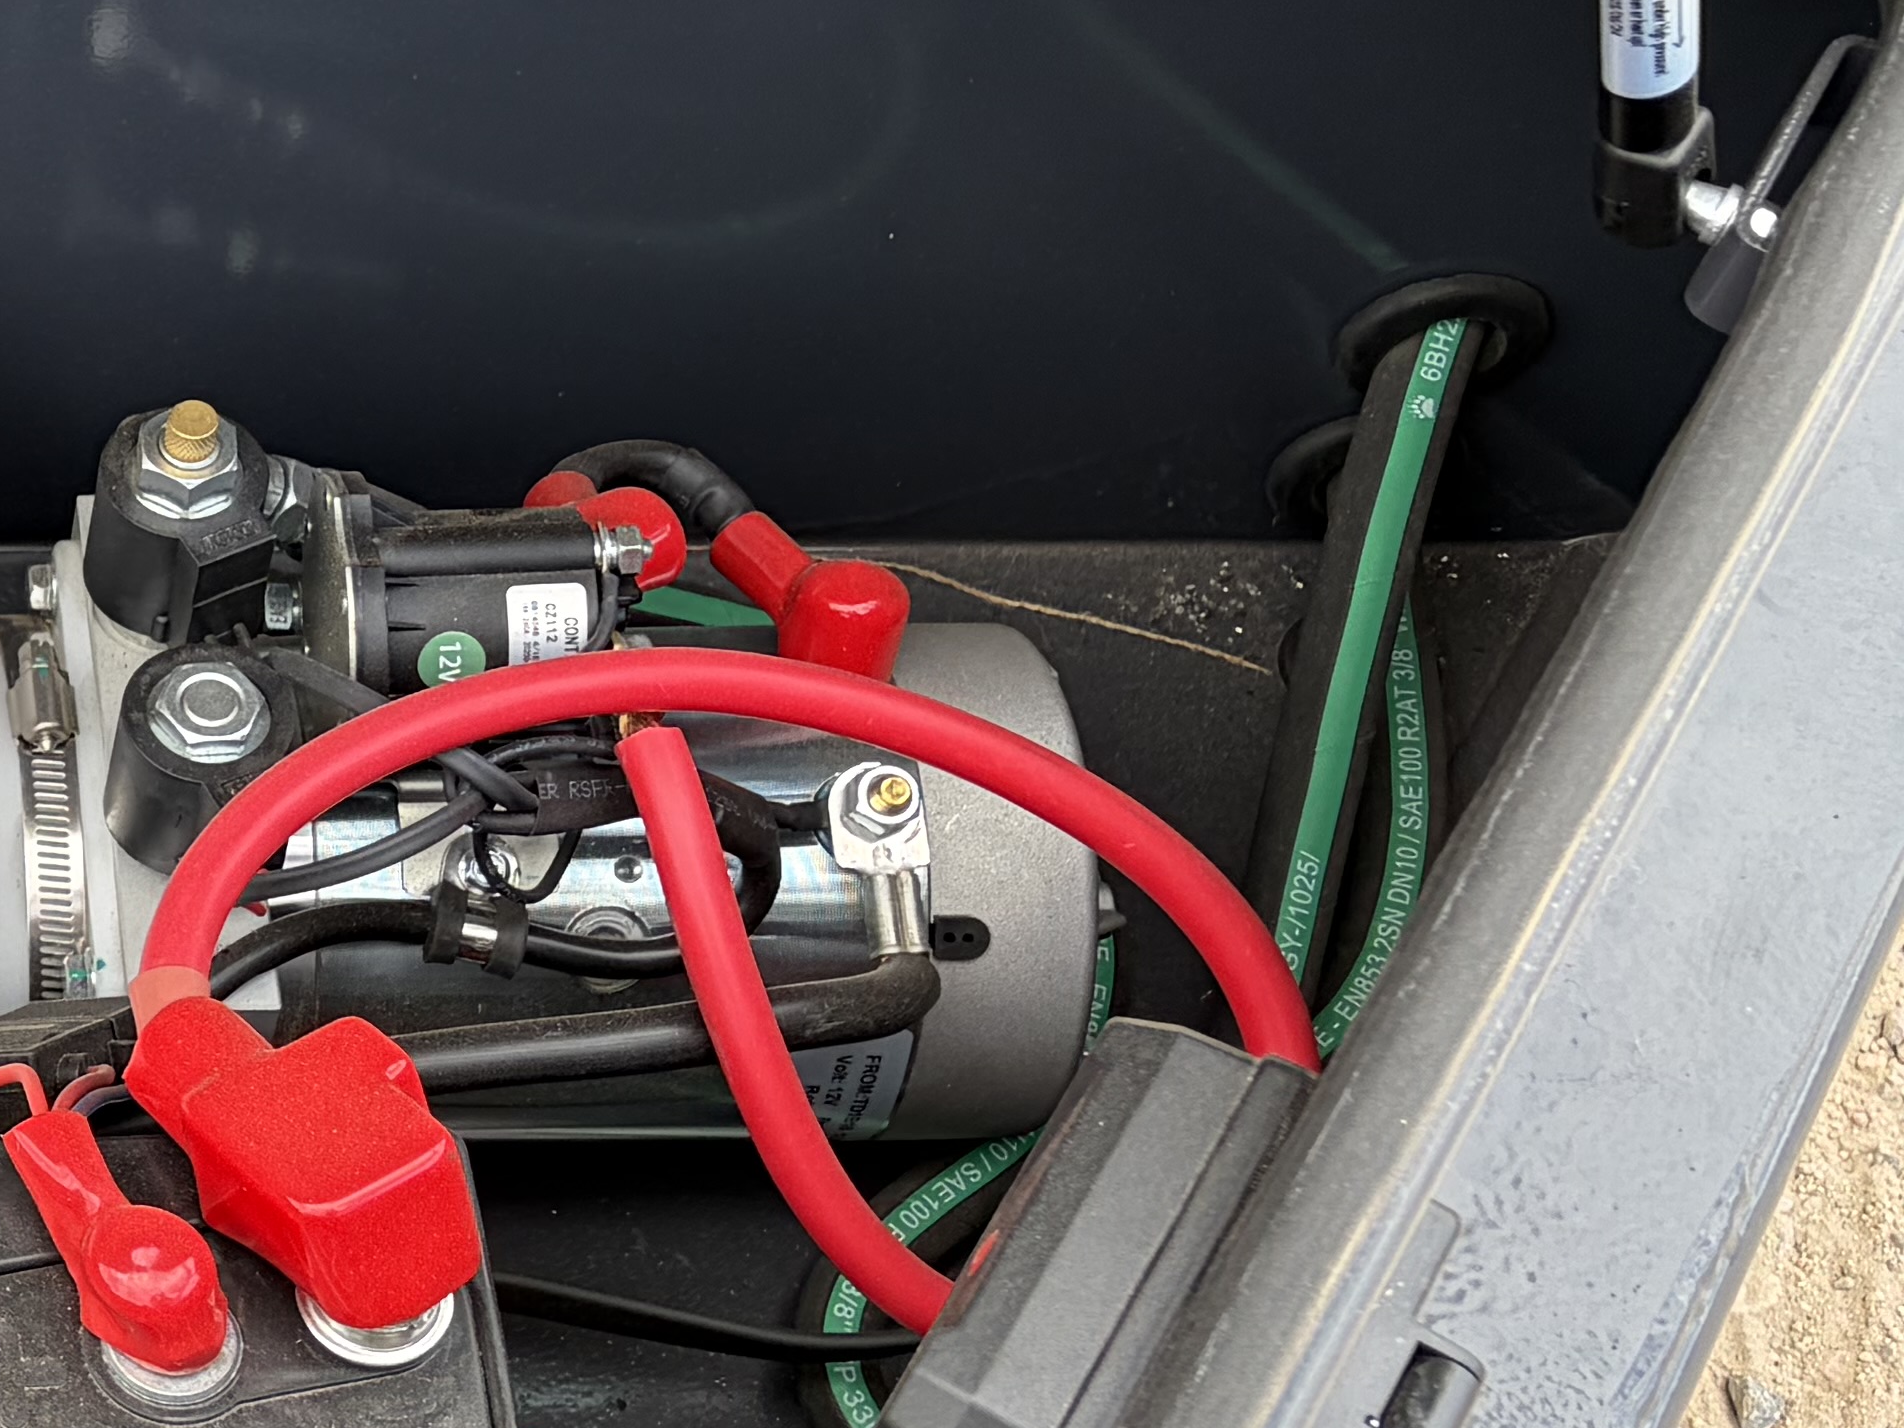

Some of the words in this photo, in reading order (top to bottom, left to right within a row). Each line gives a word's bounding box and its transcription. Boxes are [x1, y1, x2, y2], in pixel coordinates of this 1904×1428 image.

[546, 603, 559, 643] CZ112
[1395, 686, 1420, 740] R2AT
[1397, 748, 1423, 830] SAE100
[1385, 848, 1420, 904] DN10
[900, 1160, 983, 1230] SAE100
